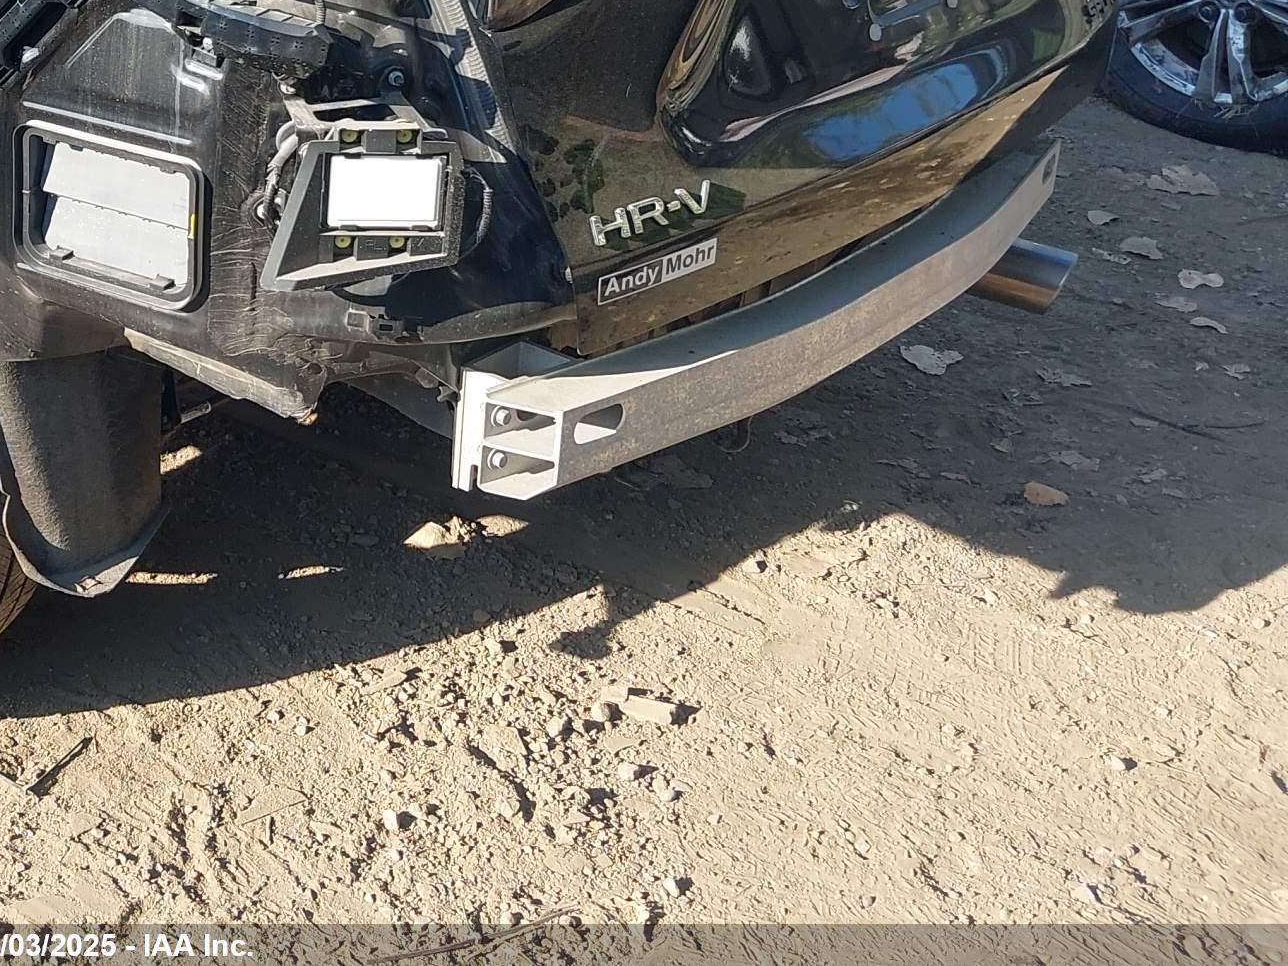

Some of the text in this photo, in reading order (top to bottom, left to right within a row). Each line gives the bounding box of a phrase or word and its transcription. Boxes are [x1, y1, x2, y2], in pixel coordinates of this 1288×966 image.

[589, 179, 711, 247] HR-V
[603, 243, 716, 298] Andy Mohr
